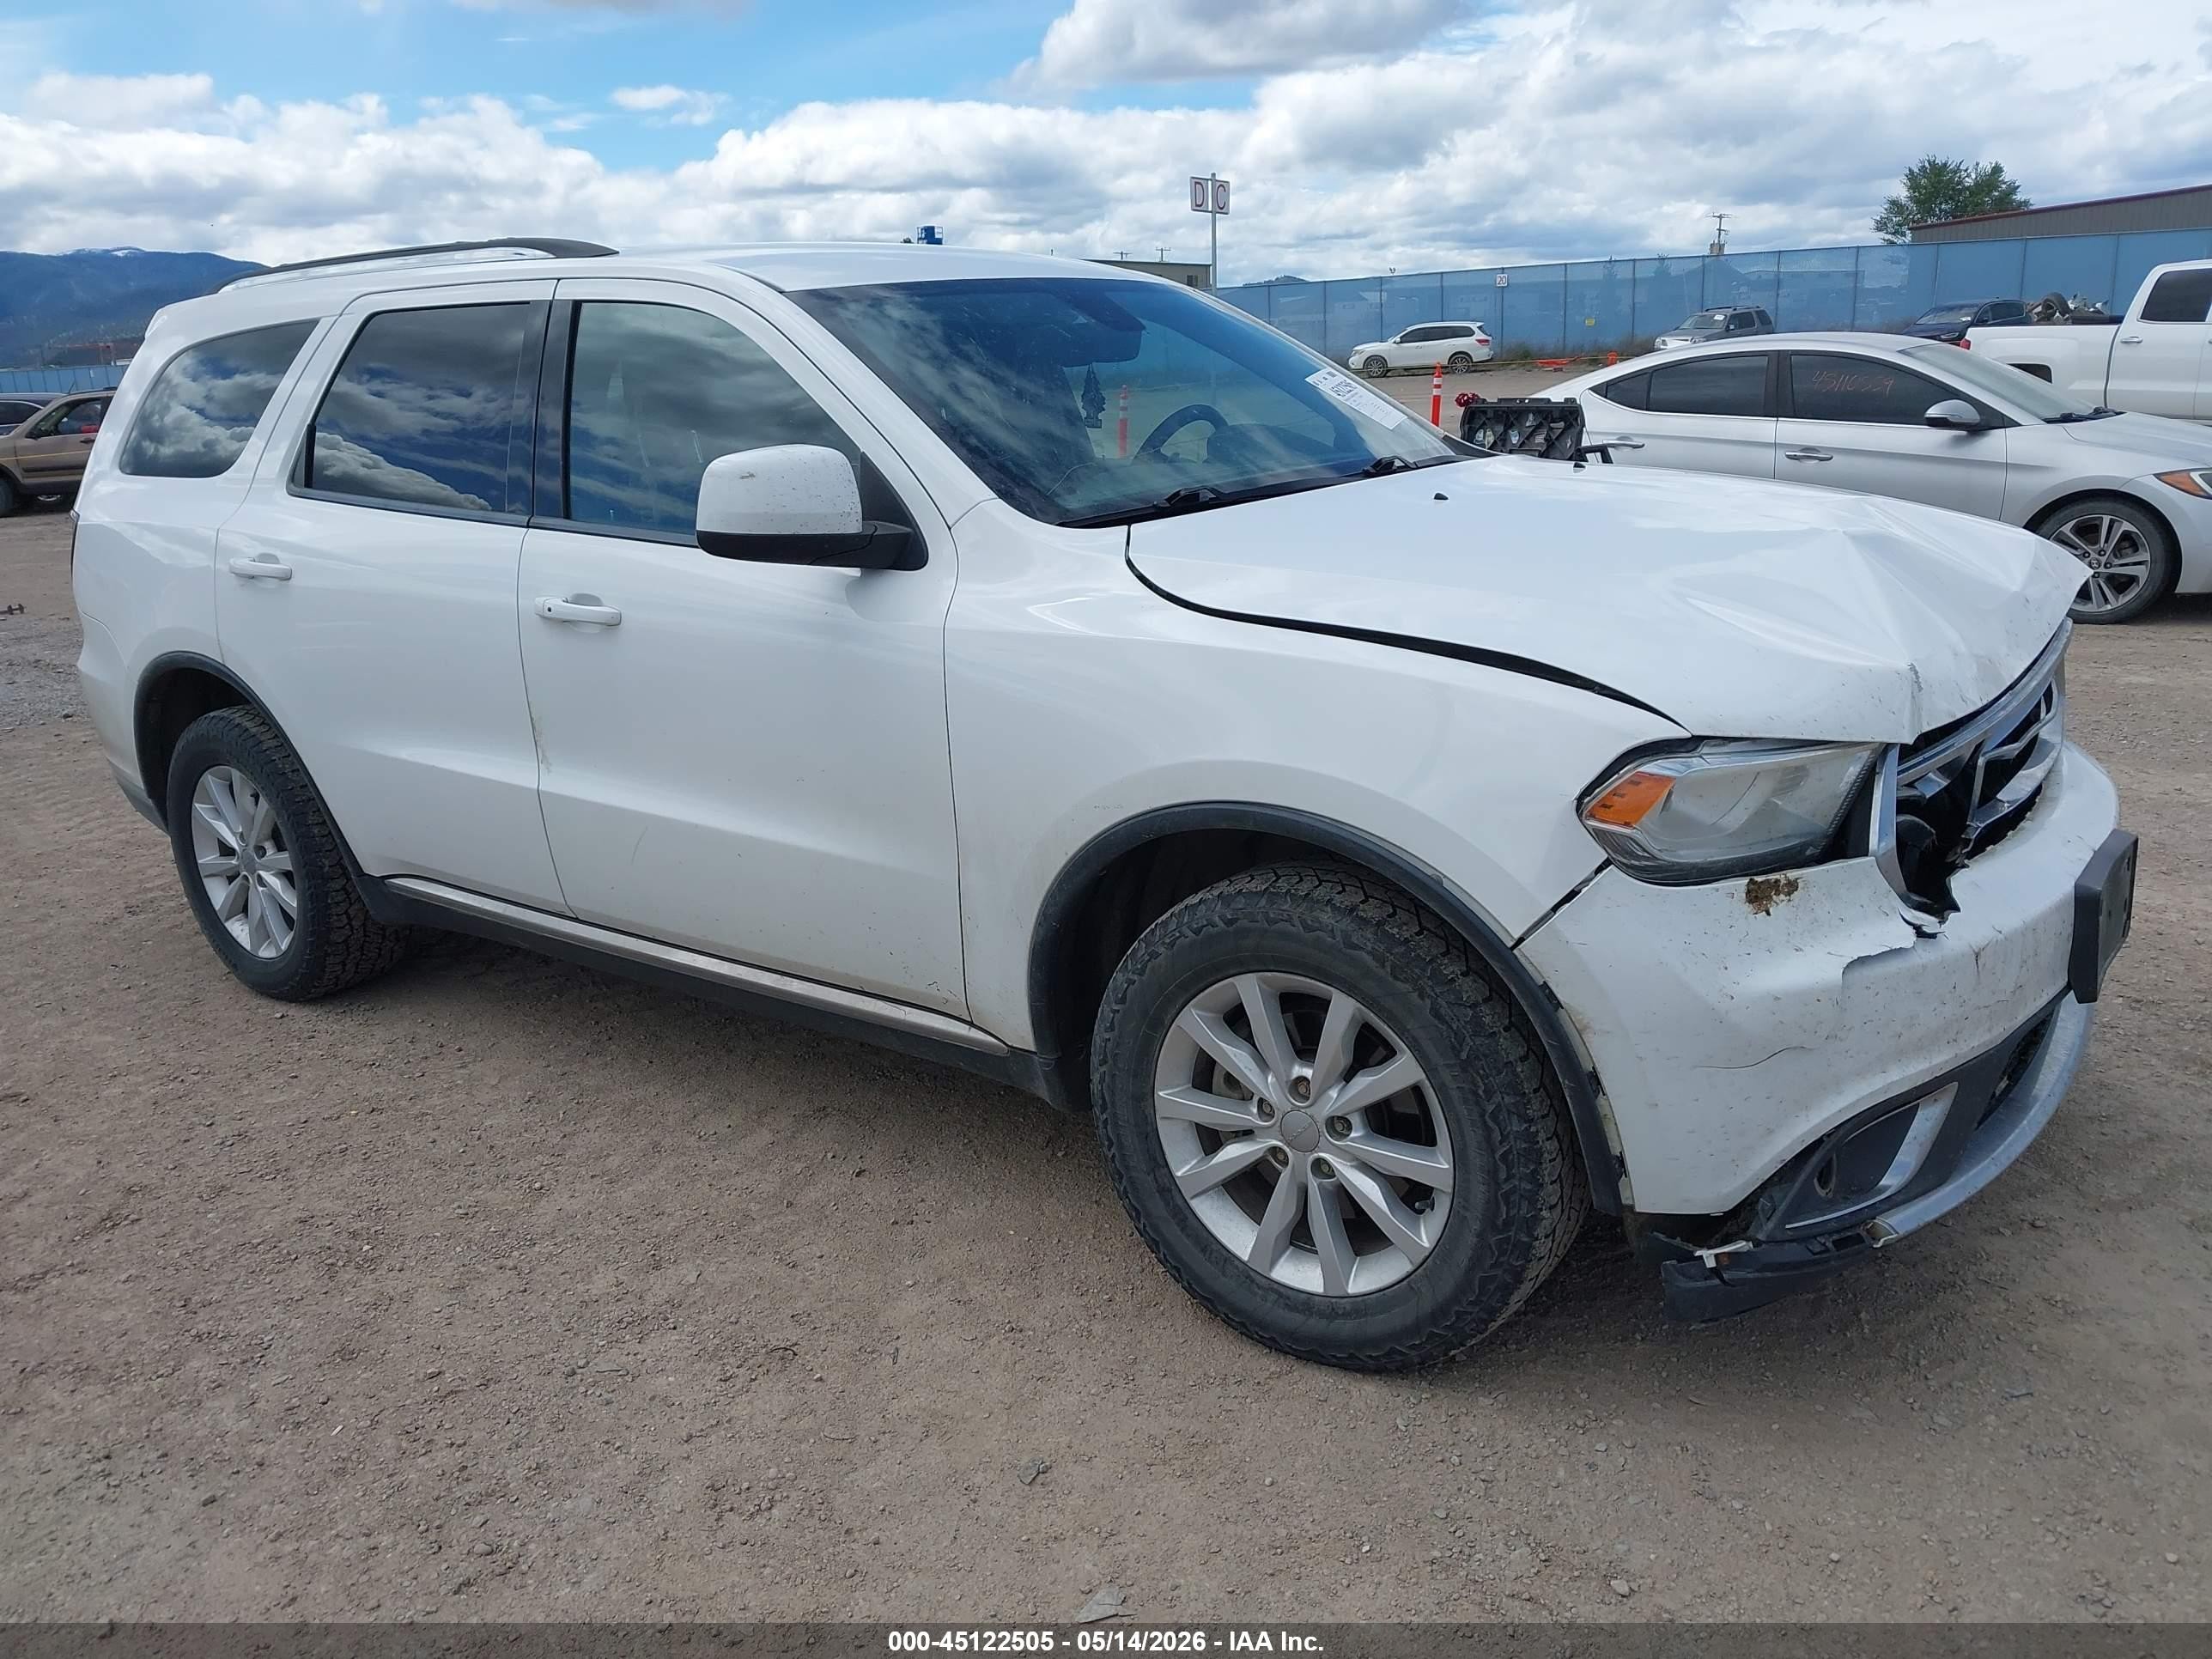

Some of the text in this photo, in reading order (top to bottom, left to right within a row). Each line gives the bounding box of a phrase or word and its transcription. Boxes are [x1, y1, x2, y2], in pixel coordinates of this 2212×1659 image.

[1194, 181, 1226, 210] D C
[1498, 276, 1507, 285] 20
